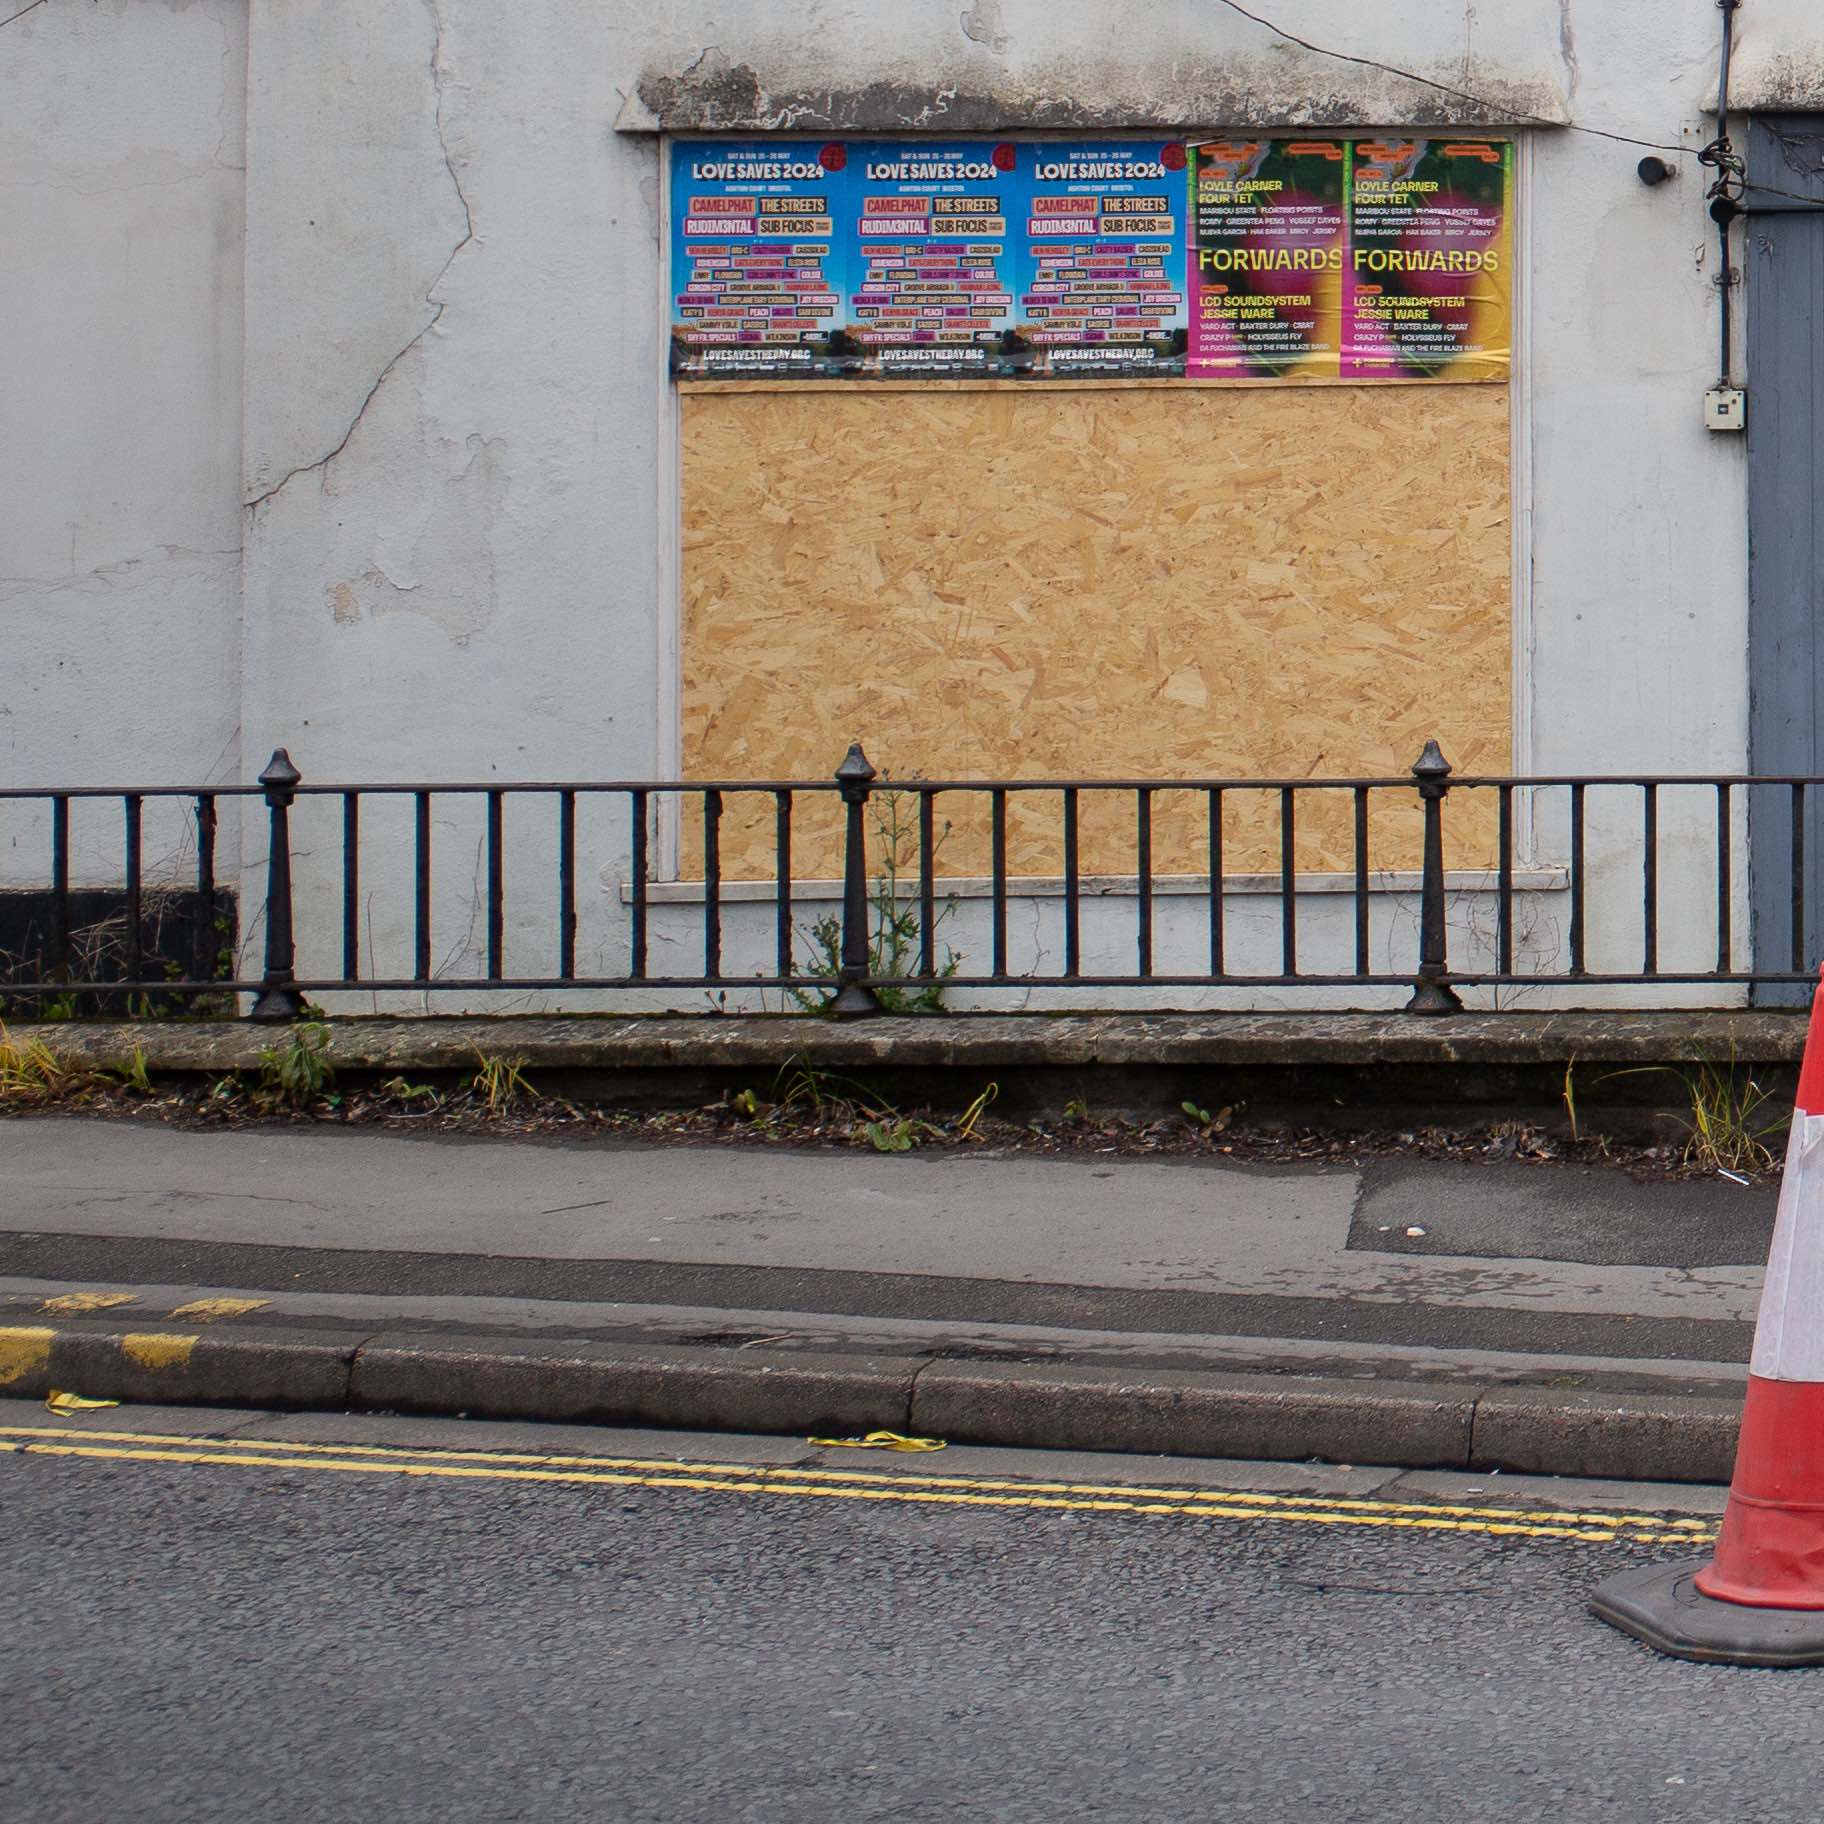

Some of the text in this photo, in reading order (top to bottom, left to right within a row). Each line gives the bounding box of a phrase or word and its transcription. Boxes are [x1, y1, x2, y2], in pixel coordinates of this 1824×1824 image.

[693, 163, 824, 179] LOVE SAVES 2024
[867, 163, 997, 179] LOVE SAVES 2024
[1036, 163, 1166, 179] LOVE SAVES 2024
[1236, 181, 1283, 191] CARNER
[1392, 182, 1439, 191] CARNER
[1199, 193, 1253, 203] FOUR TET
[1355, 194, 1409, 204] FOUR TET
[693, 199, 824, 212] CAMELPHAT THE STREETS
[867, 199, 998, 212] CAMELPHAT THE STREETS
[1036, 199, 1166, 212] CAMELPHAT THE STREETS
[761, 220, 780, 233] SUB
[782, 220, 814, 233] FOCUS
[935, 220, 954, 233] SUB
[956, 220, 987, 233] FOCUS
[1104, 220, 1123, 232] SUB
[1125, 219, 1156, 232] FOCUS
[1200, 249, 1343, 270] FORWARDS
[1354, 250, 1499, 271] FORWARDS
[1200, 296, 1311, 306] LCD SOUNDSYSTEM
[1354, 296, 1465, 307] LCD SOUNDSYSTEM
[1200, 308, 1275, 318] JESSIE WARE
[1354, 309, 1429, 319] JESSIE WARE
